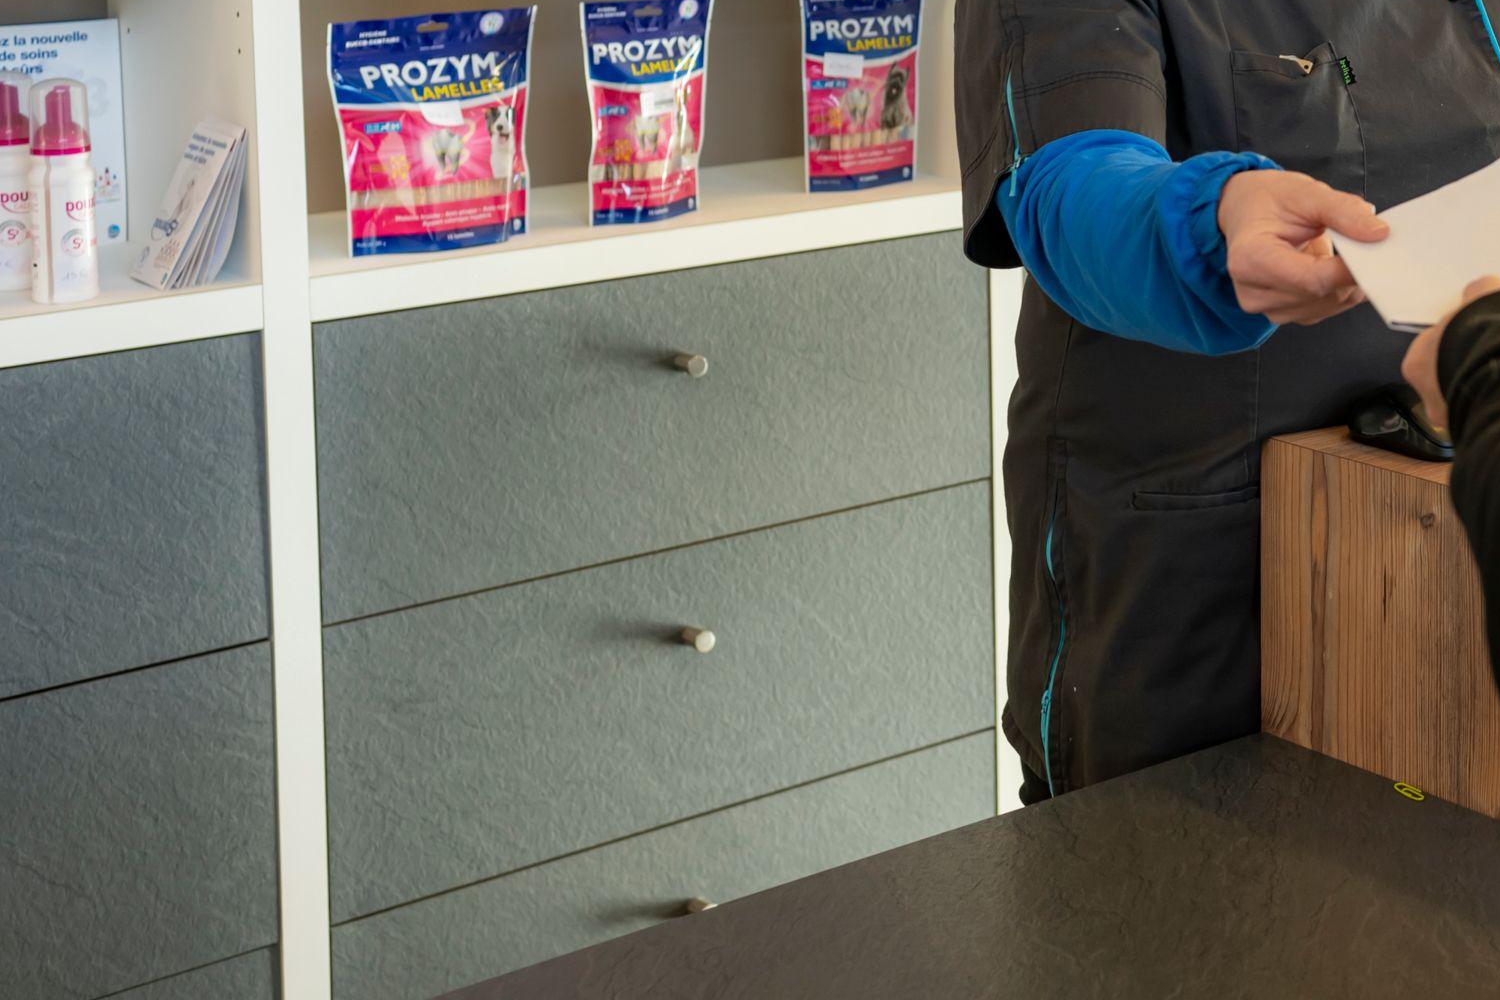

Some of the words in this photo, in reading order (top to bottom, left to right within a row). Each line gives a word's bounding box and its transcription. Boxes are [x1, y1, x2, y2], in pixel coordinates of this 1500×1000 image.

[13, 35, 26, 46] la
[30, 31, 88, 45] nouvelle
[809, 14, 914, 42] PROZYM
[20, 48, 58, 61] soins
[592, 34, 702, 65] PROZYM
[846, 35, 912, 52] LAMELLES
[359, 51, 498, 90] PROZYM
[410, 77, 505, 102] LAMELLES
